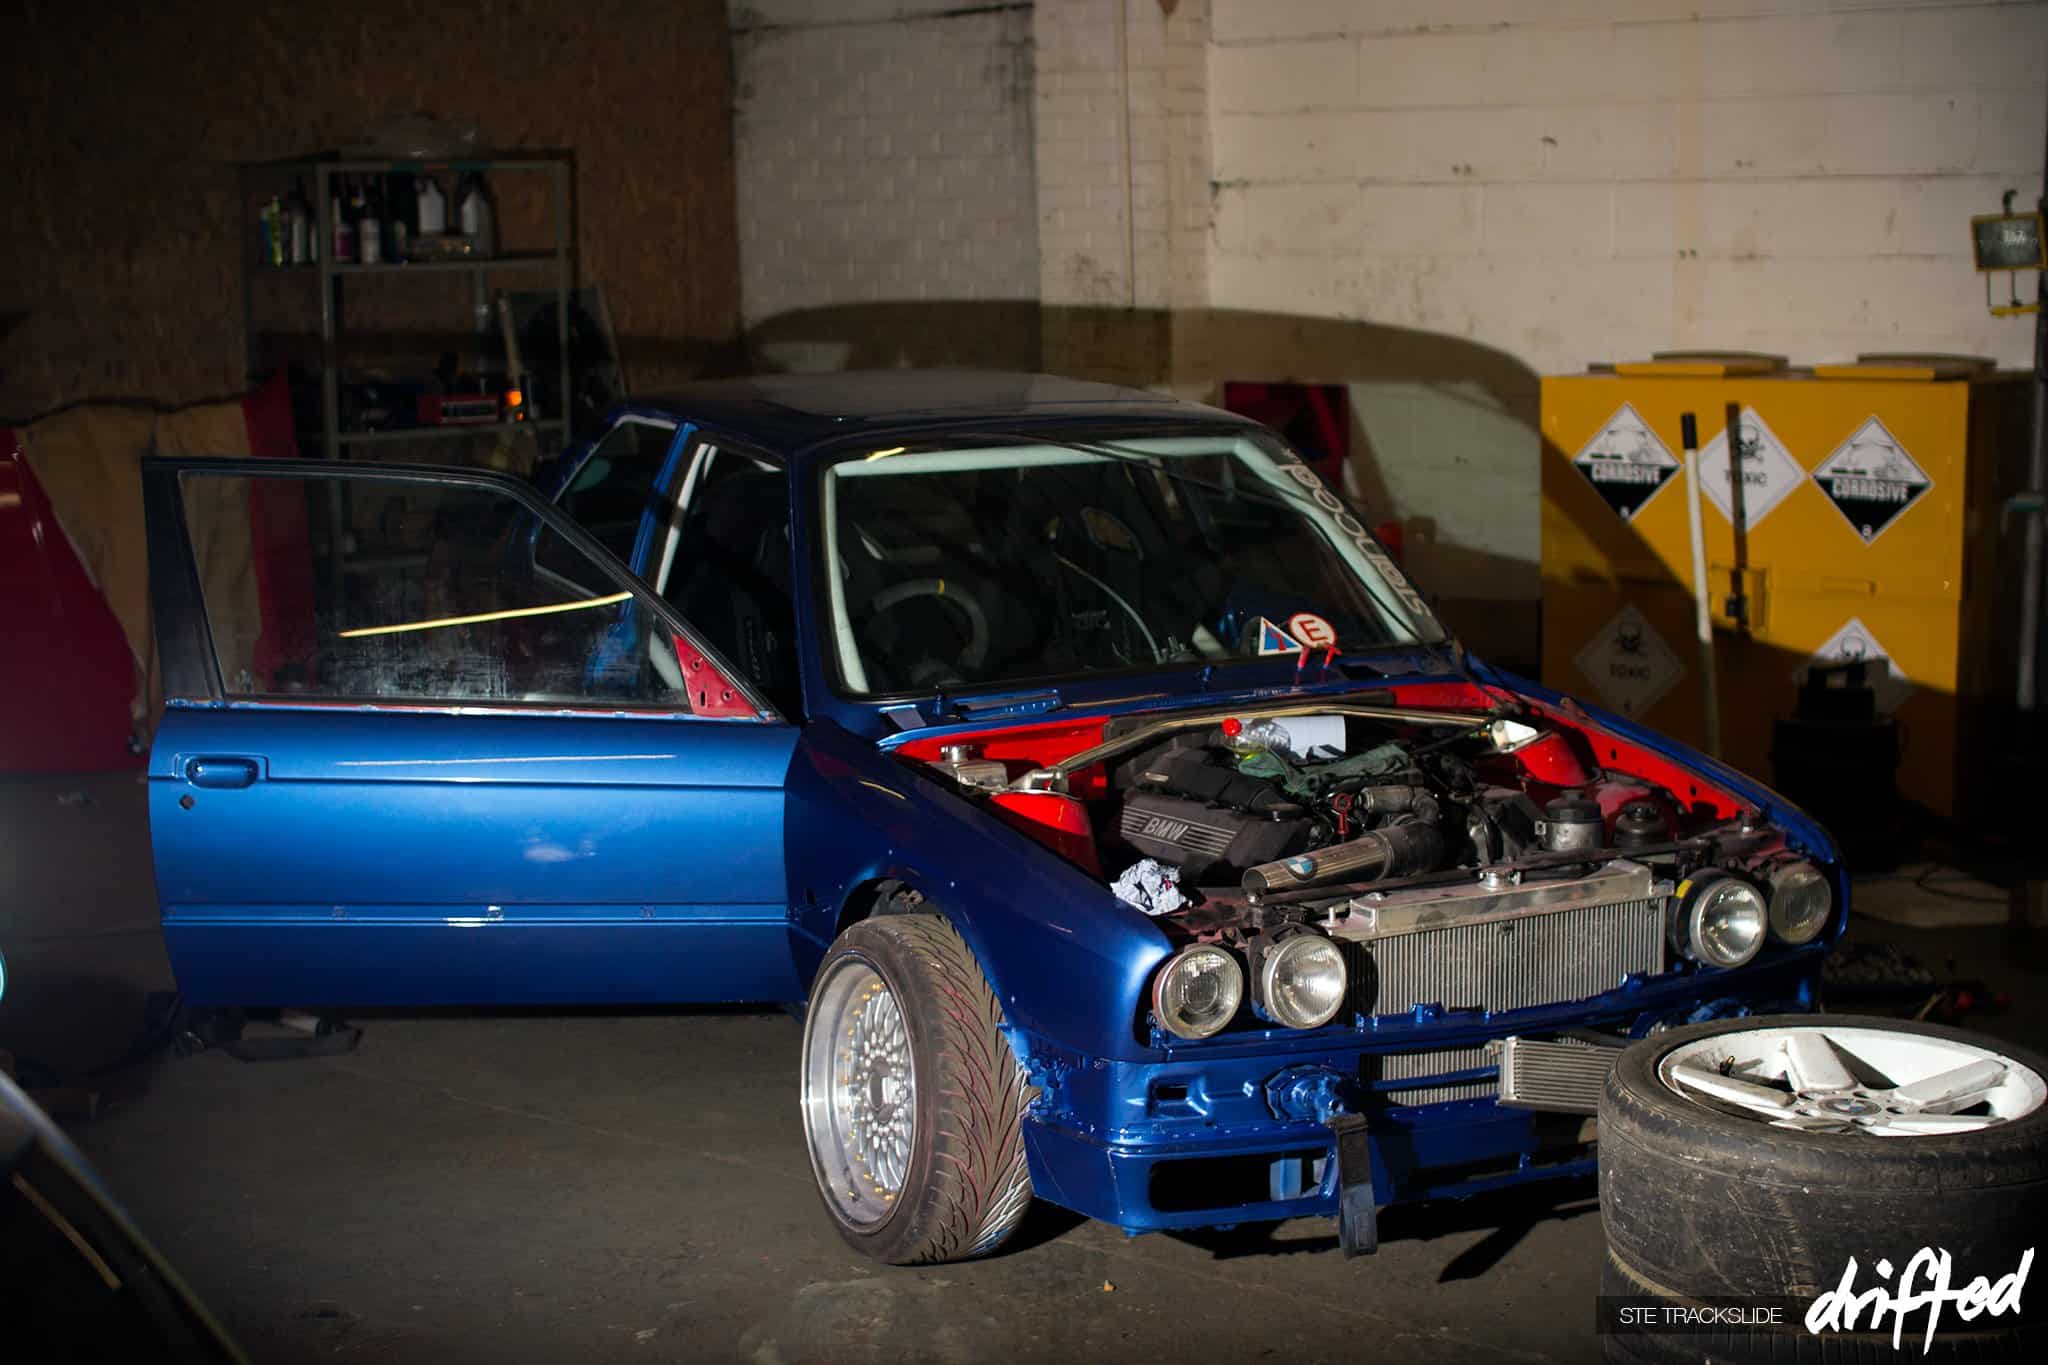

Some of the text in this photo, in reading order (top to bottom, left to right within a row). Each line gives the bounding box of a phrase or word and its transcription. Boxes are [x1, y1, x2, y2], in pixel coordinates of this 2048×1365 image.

[1591, 463, 1661, 484] CORROSIVE
[1723, 469, 1768, 488] TXIC
[1832, 478, 1909, 502] CORROSIVE
[1297, 619, 1329, 643] E
[1142, 817, 1189, 841] BMW
